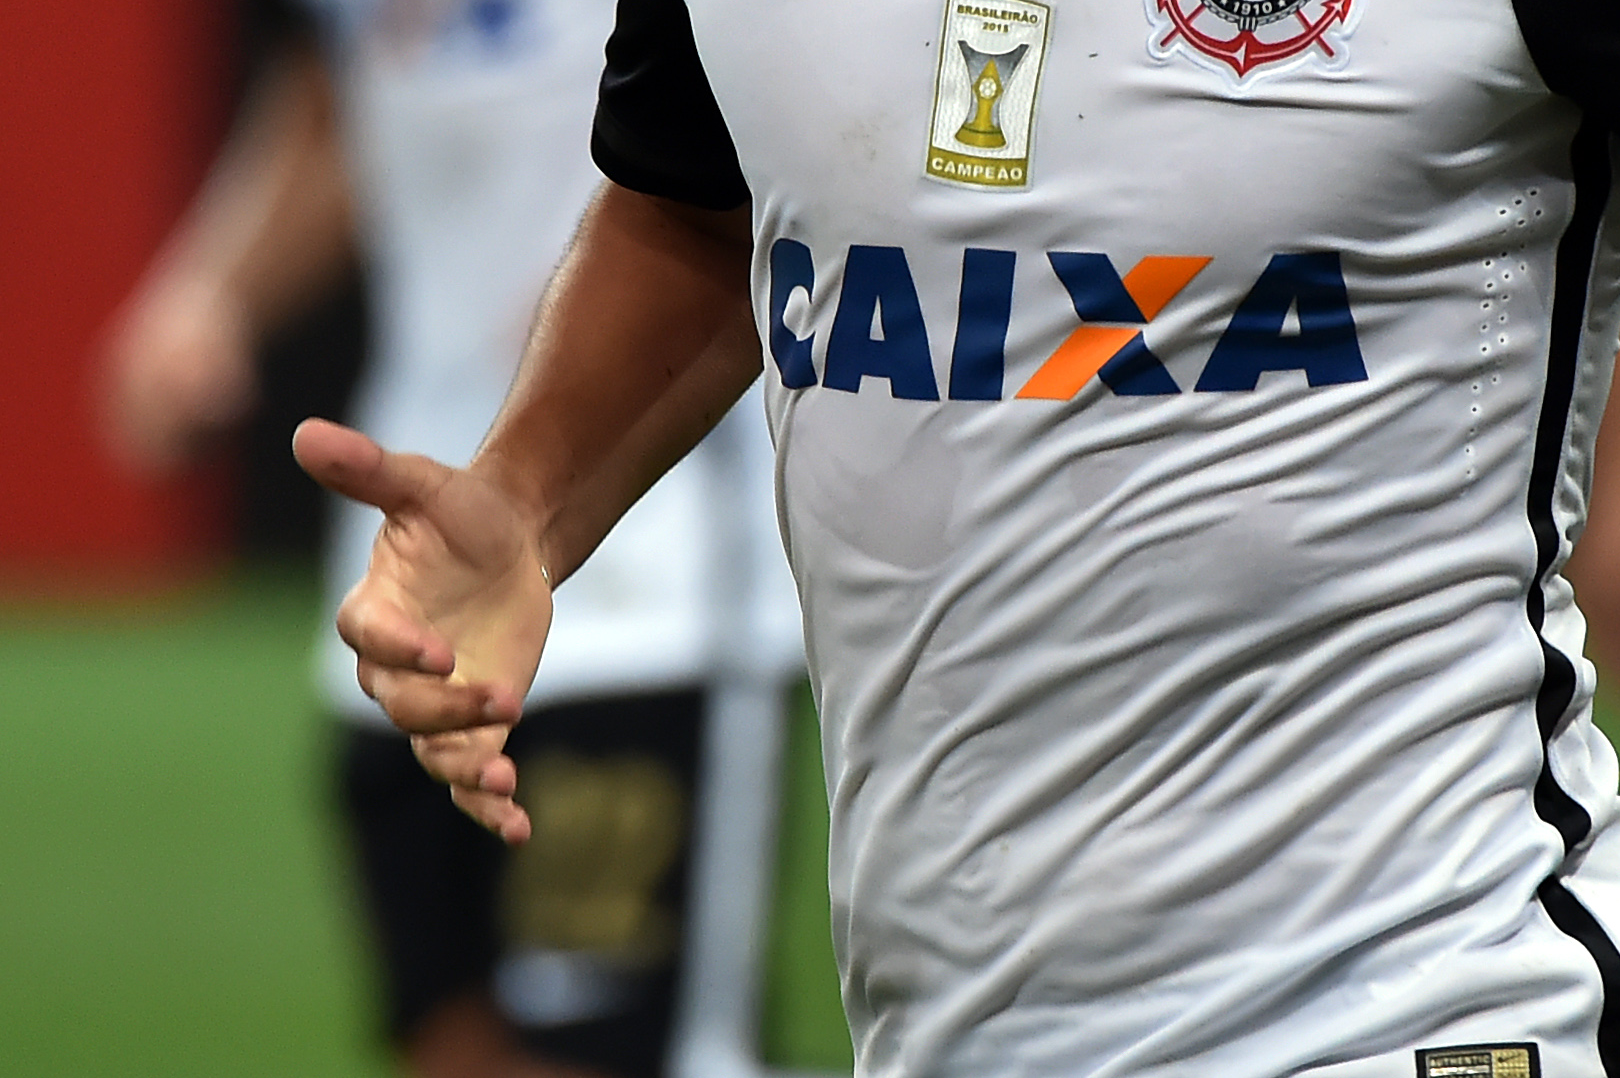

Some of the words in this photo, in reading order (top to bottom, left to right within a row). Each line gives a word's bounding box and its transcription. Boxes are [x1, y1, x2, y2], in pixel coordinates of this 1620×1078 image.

[1232, 1, 1273, 16] 1910
[769, 237, 1370, 403] CAIXA
[1430, 1054, 1490, 1067] AUTHENTIC
